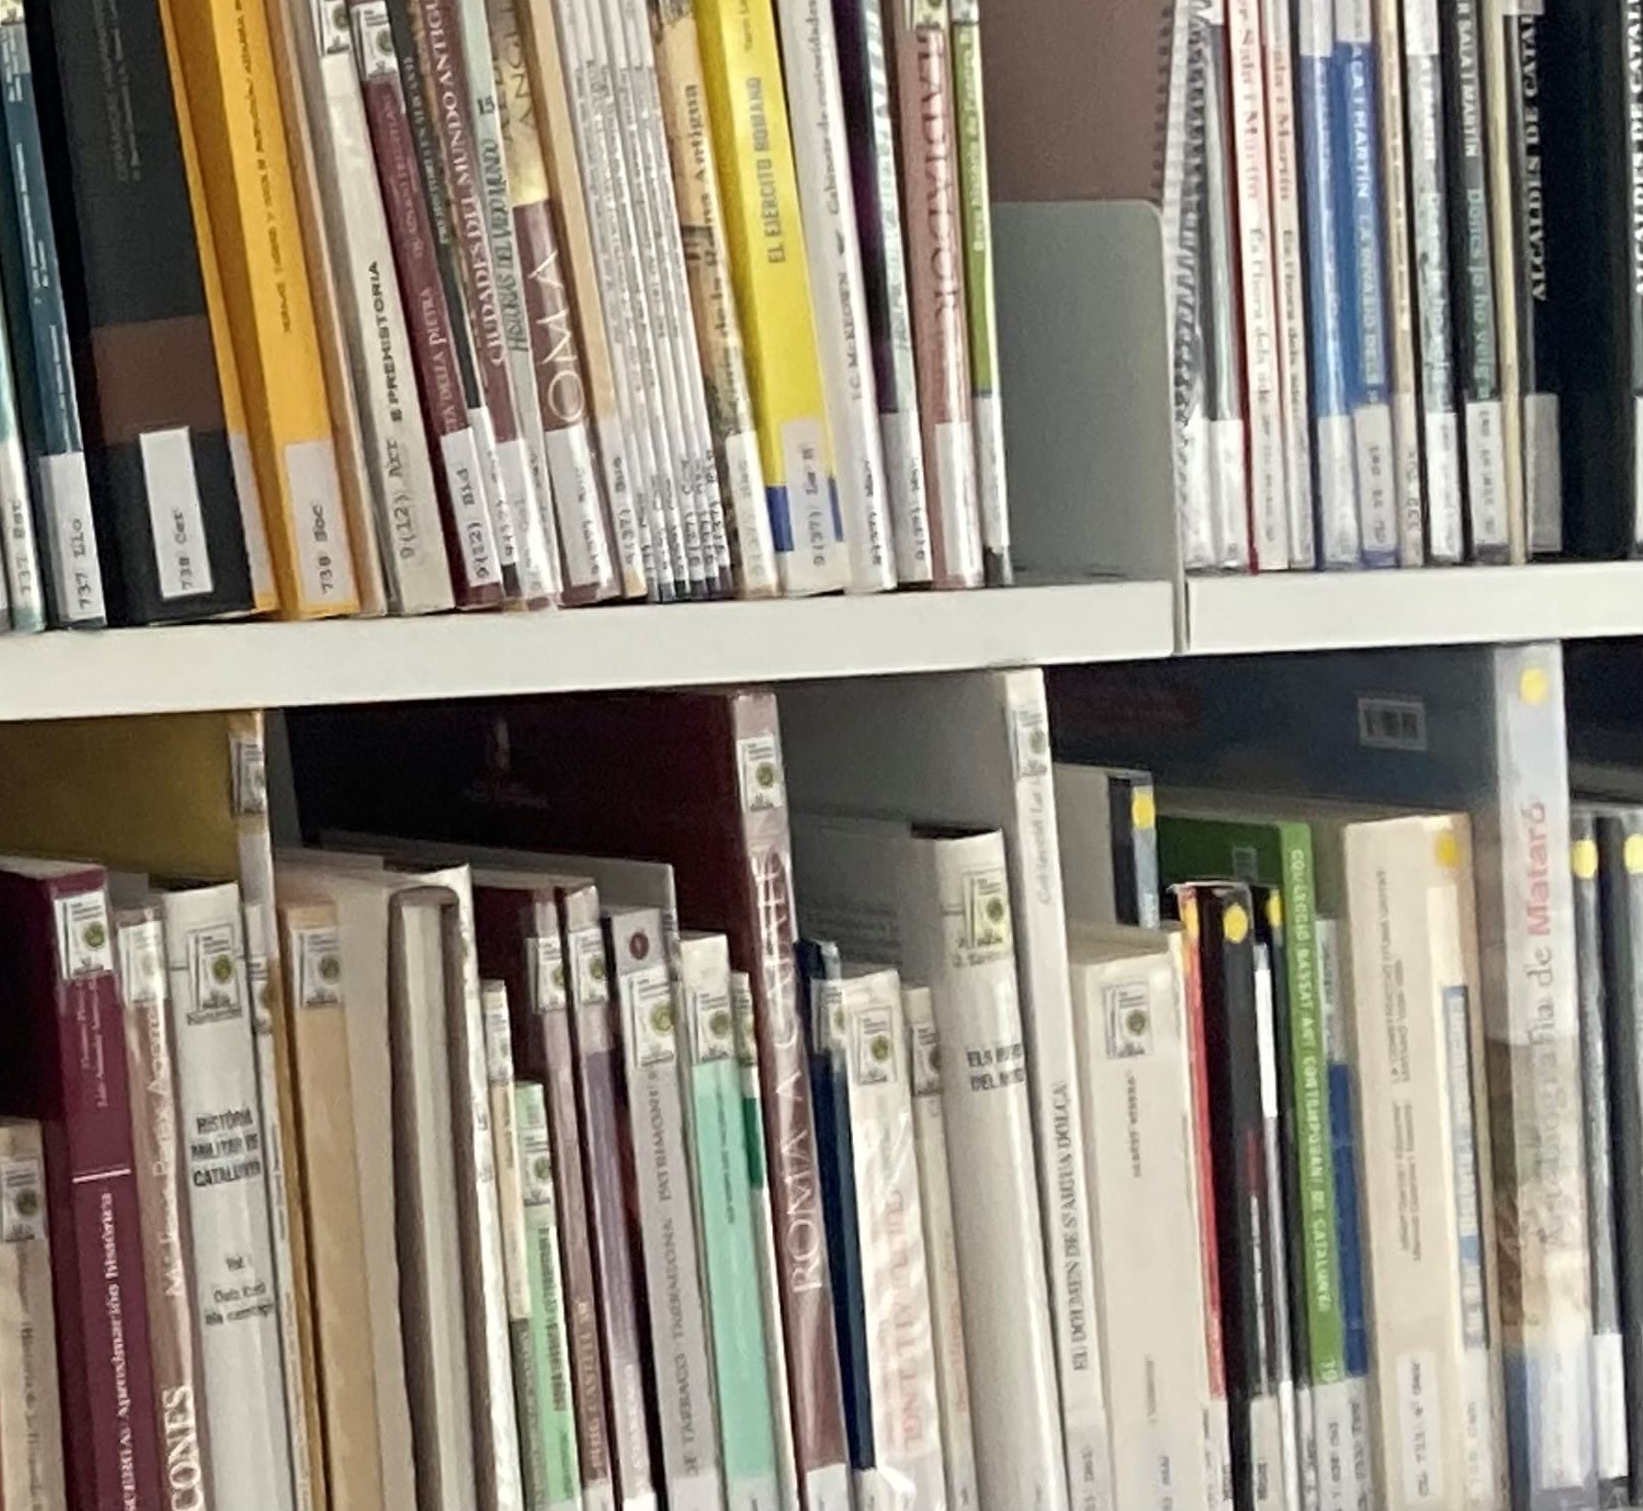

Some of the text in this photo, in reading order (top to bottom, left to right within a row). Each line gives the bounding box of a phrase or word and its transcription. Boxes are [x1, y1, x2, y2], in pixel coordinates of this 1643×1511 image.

[1455, 19, 1474, 68] SALA
[442, 92, 474, 187] MUNDO
[1461, 83, 1481, 158] MARTÍN
[1627, 101, 1643, 141] DE
[745, 76, 787, 264] EL EJÉRCITO ROMANO
[1353, 110, 1370, 199] MARTÍN
[1519, 14, 1547, 300] ALCALDES DE CATAL
[460, 193, 482, 239] DEL
[1467, 191, 1486, 259] Doncs
[368, 260, 399, 404] PREHISTORIA
[470, 242, 505, 365] CIUDADES
[526, 251, 585, 422] OMA
[1473, 295, 1490, 323] ho
[396, 492, 415, 560] 9(12)
[469, 521, 490, 579] 9(12)
[808, 510, 826, 566] 9(37)
[76, 571, 93, 609] 737
[317, 555, 335, 595] 738
[1519, 801, 1553, 938] Mataró
[1294, 947, 1313, 1010] BASSAT
[1523, 946, 1556, 989] de
[1299, 1015, 1315, 1049] ART
[773, 1069, 803, 1103] A
[1048, 1083, 1074, 1149] DOLÇA
[647, 1091, 673, 1203] PATRIMONI
[779, 1128, 823, 1295] ROMA
[1310, 1189, 1328, 1211] DE
[1063, 1232, 1081, 1259] DE
[1310, 1217, 1333, 1313] CATALUNYA
[1065, 1261, 1087, 1342] DOLMEN
[1071, 1349, 1089, 1371] EL
